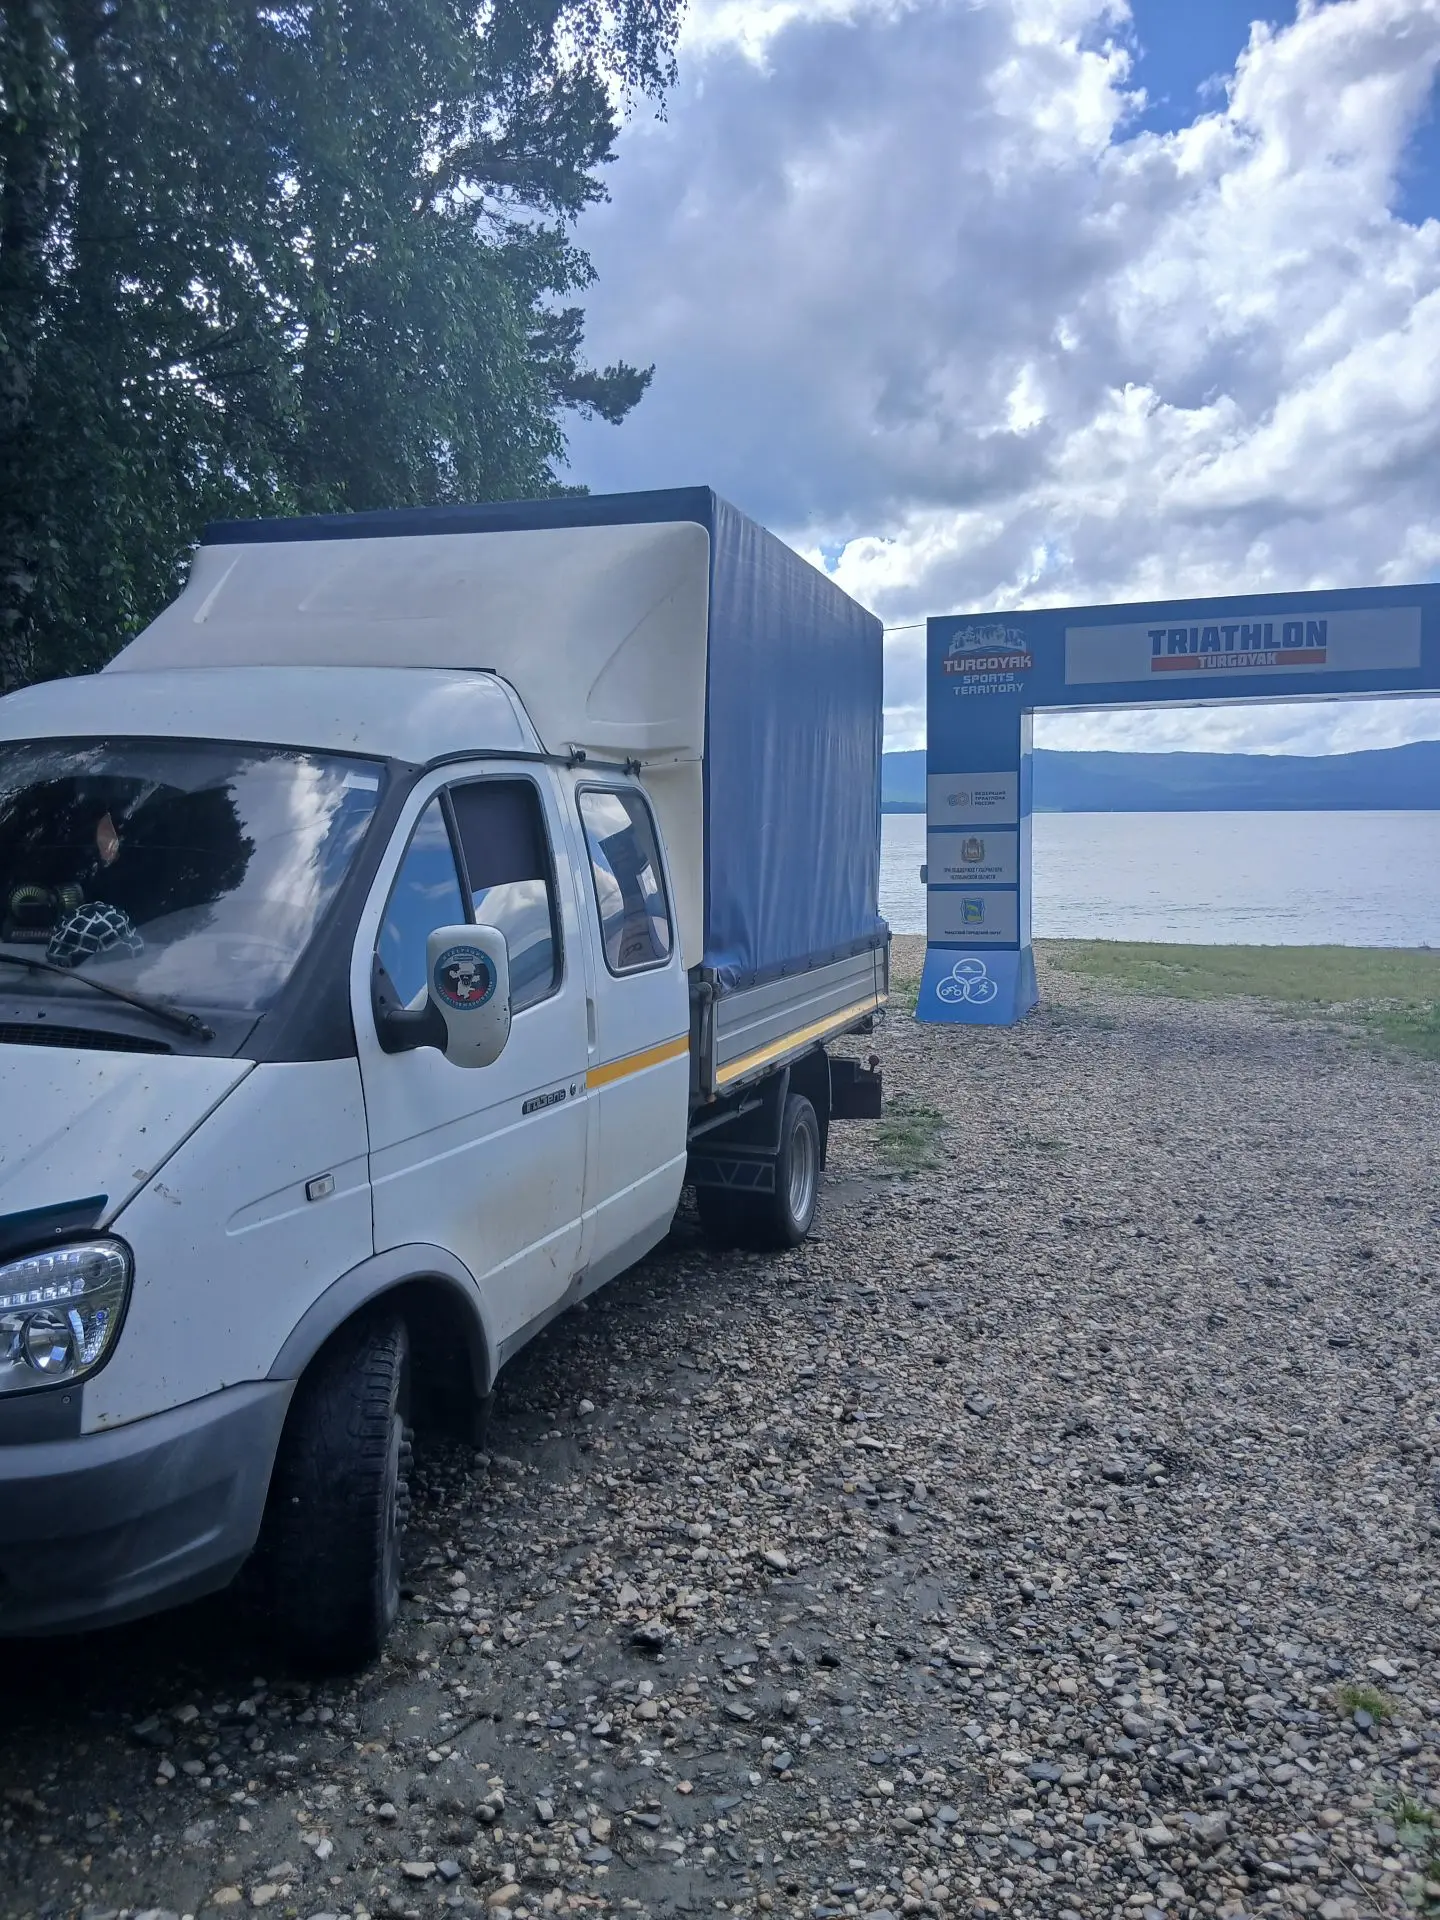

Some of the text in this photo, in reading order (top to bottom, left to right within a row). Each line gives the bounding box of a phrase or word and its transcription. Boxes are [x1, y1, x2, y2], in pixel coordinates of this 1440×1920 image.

[1148, 620, 1327, 656] TRIATHLON
[943, 656, 1032, 672] TURGOYAK
[1198, 652, 1277, 669] TURGOYAK
[963, 672, 1015, 684] SPORTS
[952, 683, 1025, 696] TERRITORY
